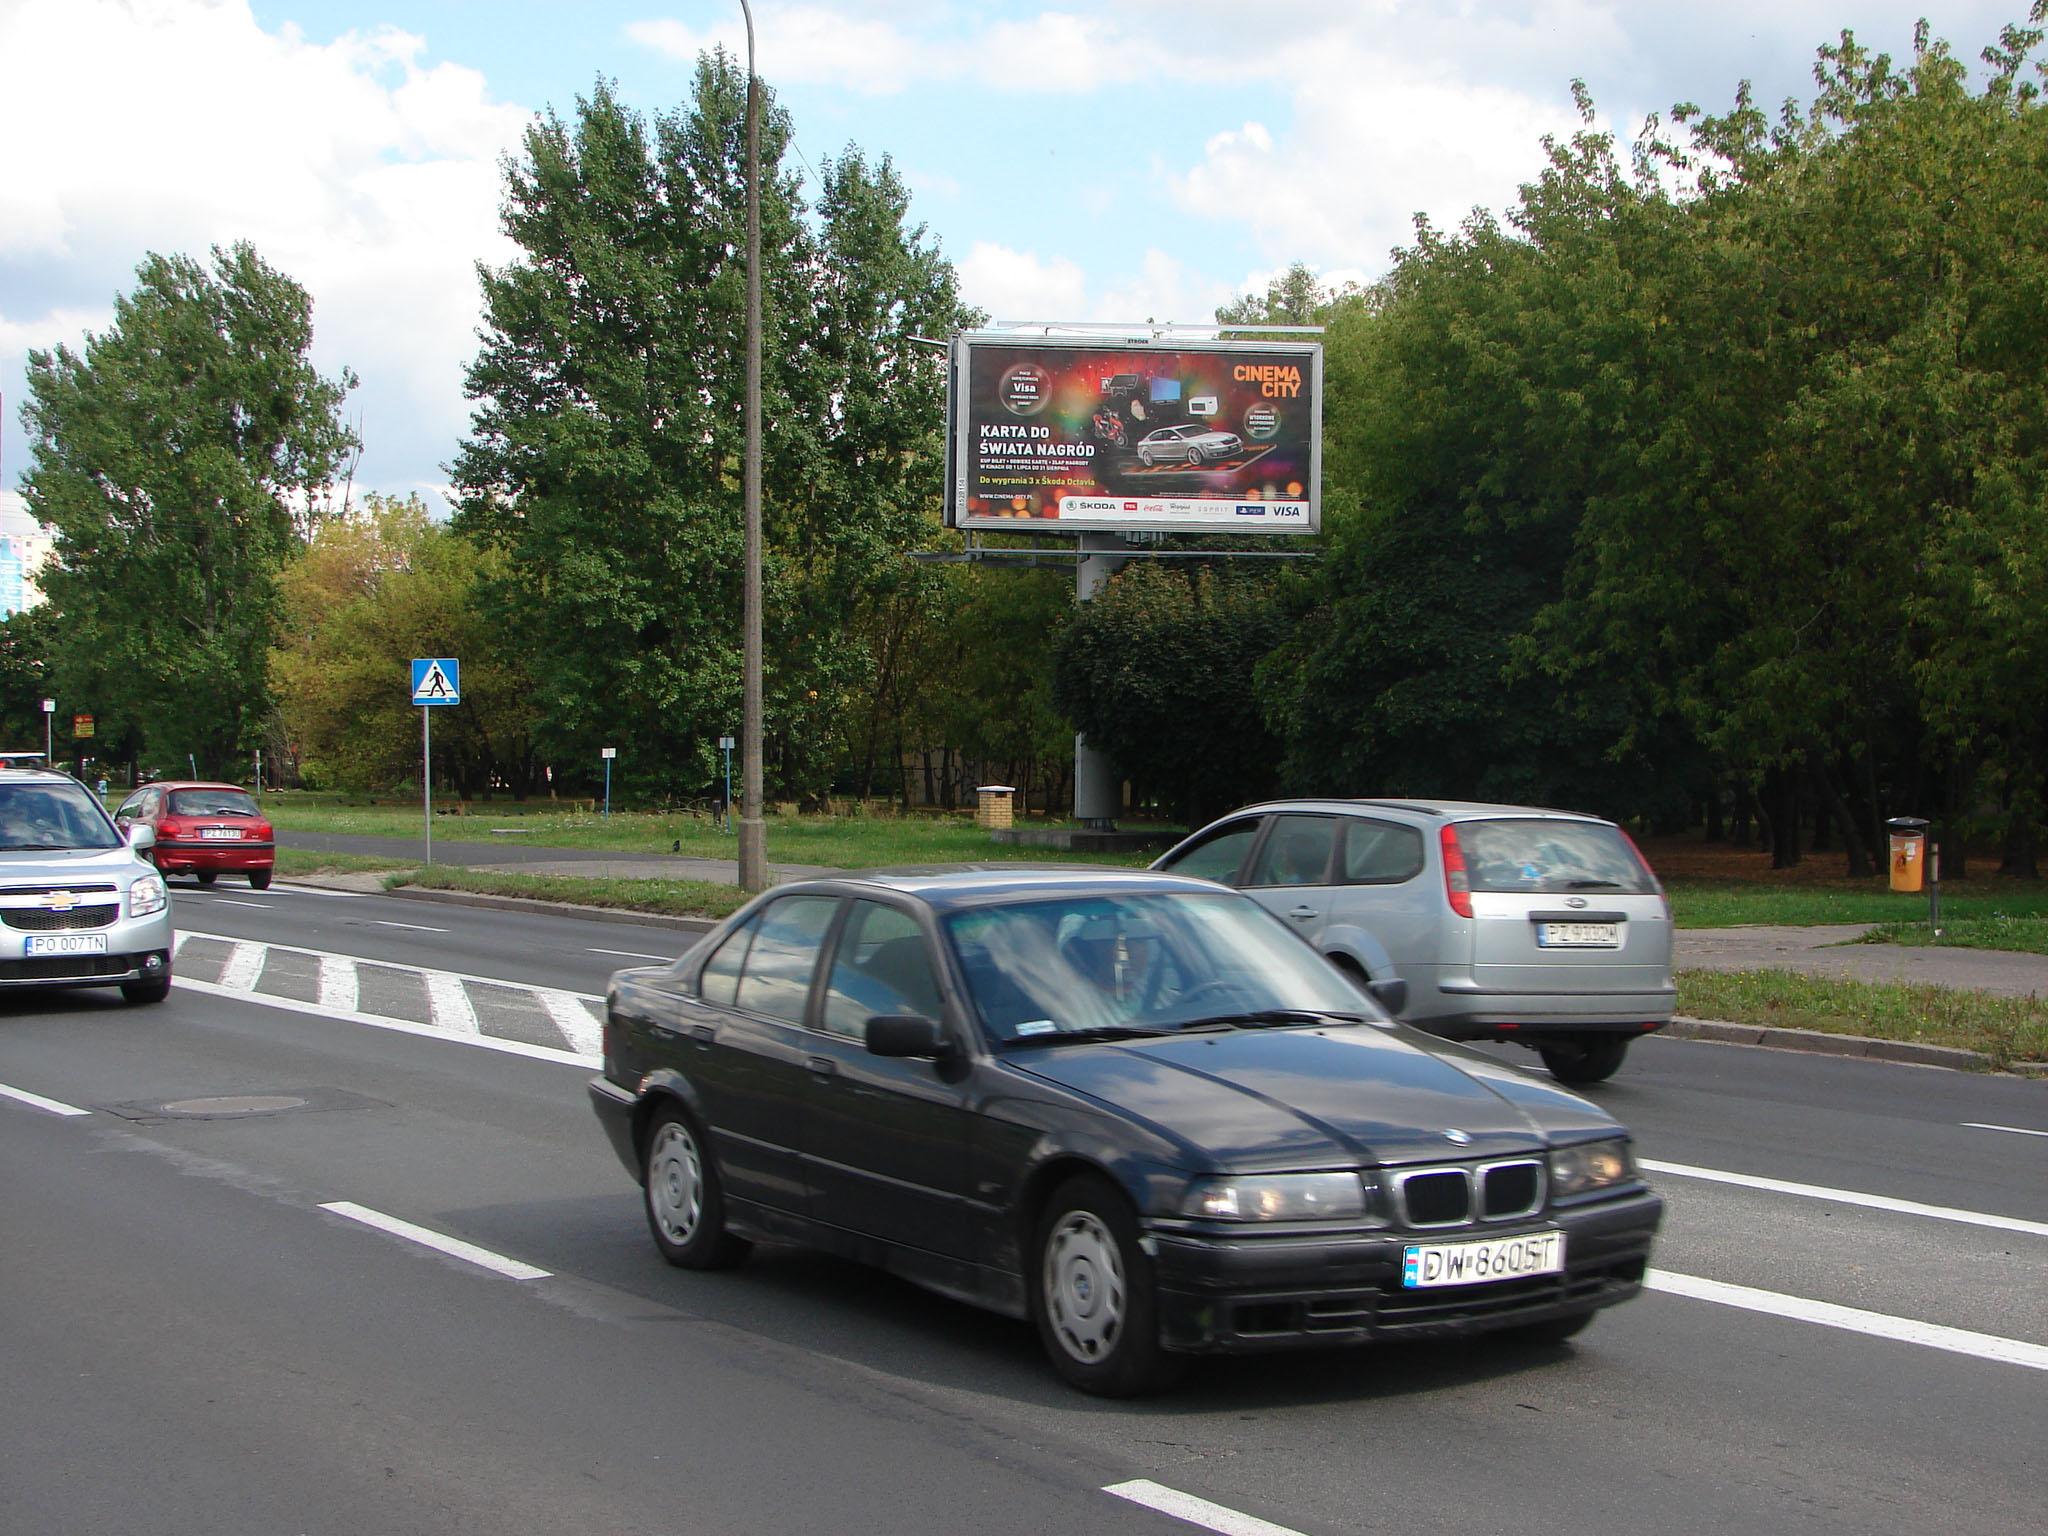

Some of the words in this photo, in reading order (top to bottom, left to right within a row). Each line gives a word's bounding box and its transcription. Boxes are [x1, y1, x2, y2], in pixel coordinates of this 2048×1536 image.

[1233, 364, 1301, 382] CINEMA
[1013, 383, 1036, 392] Visa
[1262, 381, 1301, 398] CITY
[980, 424, 1027, 438] KARTA
[1030, 426, 1050, 439] DO
[979, 439, 1034, 455] ŚWIATA
[1036, 441, 1095, 457] NAGRÓD
[979, 475, 991, 484] Do
[991, 477, 1027, 487] wygrania
[1041, 475, 1065, 486] Škoda
[1066, 477, 1095, 486] Octavia
[1079, 501, 1116, 510] ŠKODA
[1273, 506, 1300, 517] VISA
[35, 938, 56, 951] PO
[60, 936, 104, 951] 007TN
[1423, 1248, 1465, 1281] DW
[1475, 1237, 1556, 1276] 8605T
